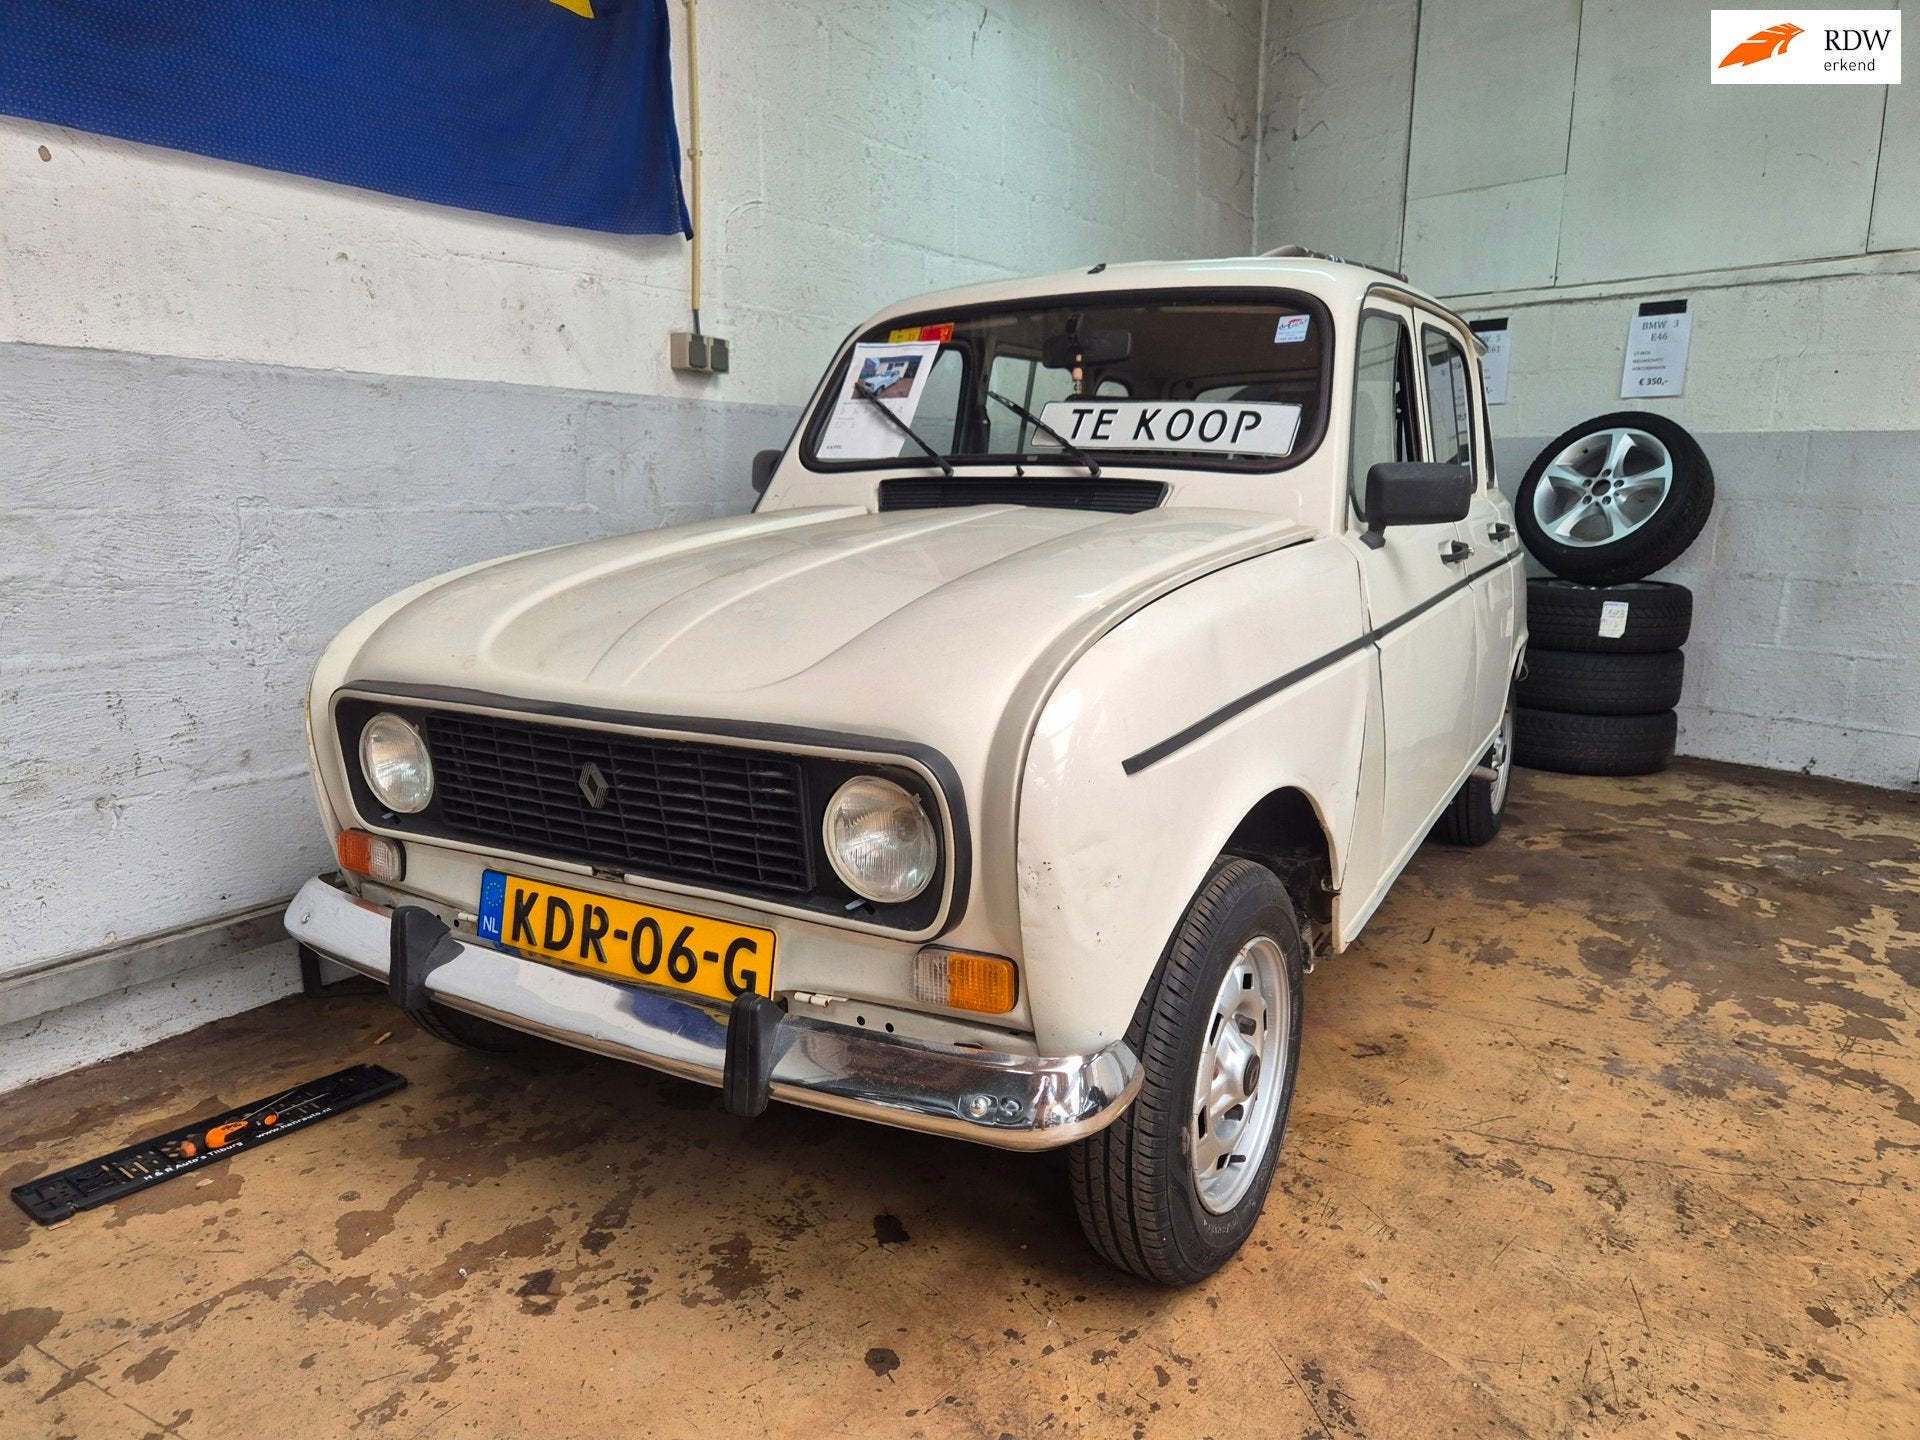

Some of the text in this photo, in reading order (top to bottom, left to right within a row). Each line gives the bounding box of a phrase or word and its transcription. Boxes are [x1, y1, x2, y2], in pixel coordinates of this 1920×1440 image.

[1642, 320, 1668, 331] BMW
[1650, 332, 1668, 342] E46
[1070, 408, 1263, 444] TE KOOP
[482, 915, 499, 934] NL
[511, 888, 758, 997] KDR-06-G
[207, 1141, 244, 1157] Tilburg
